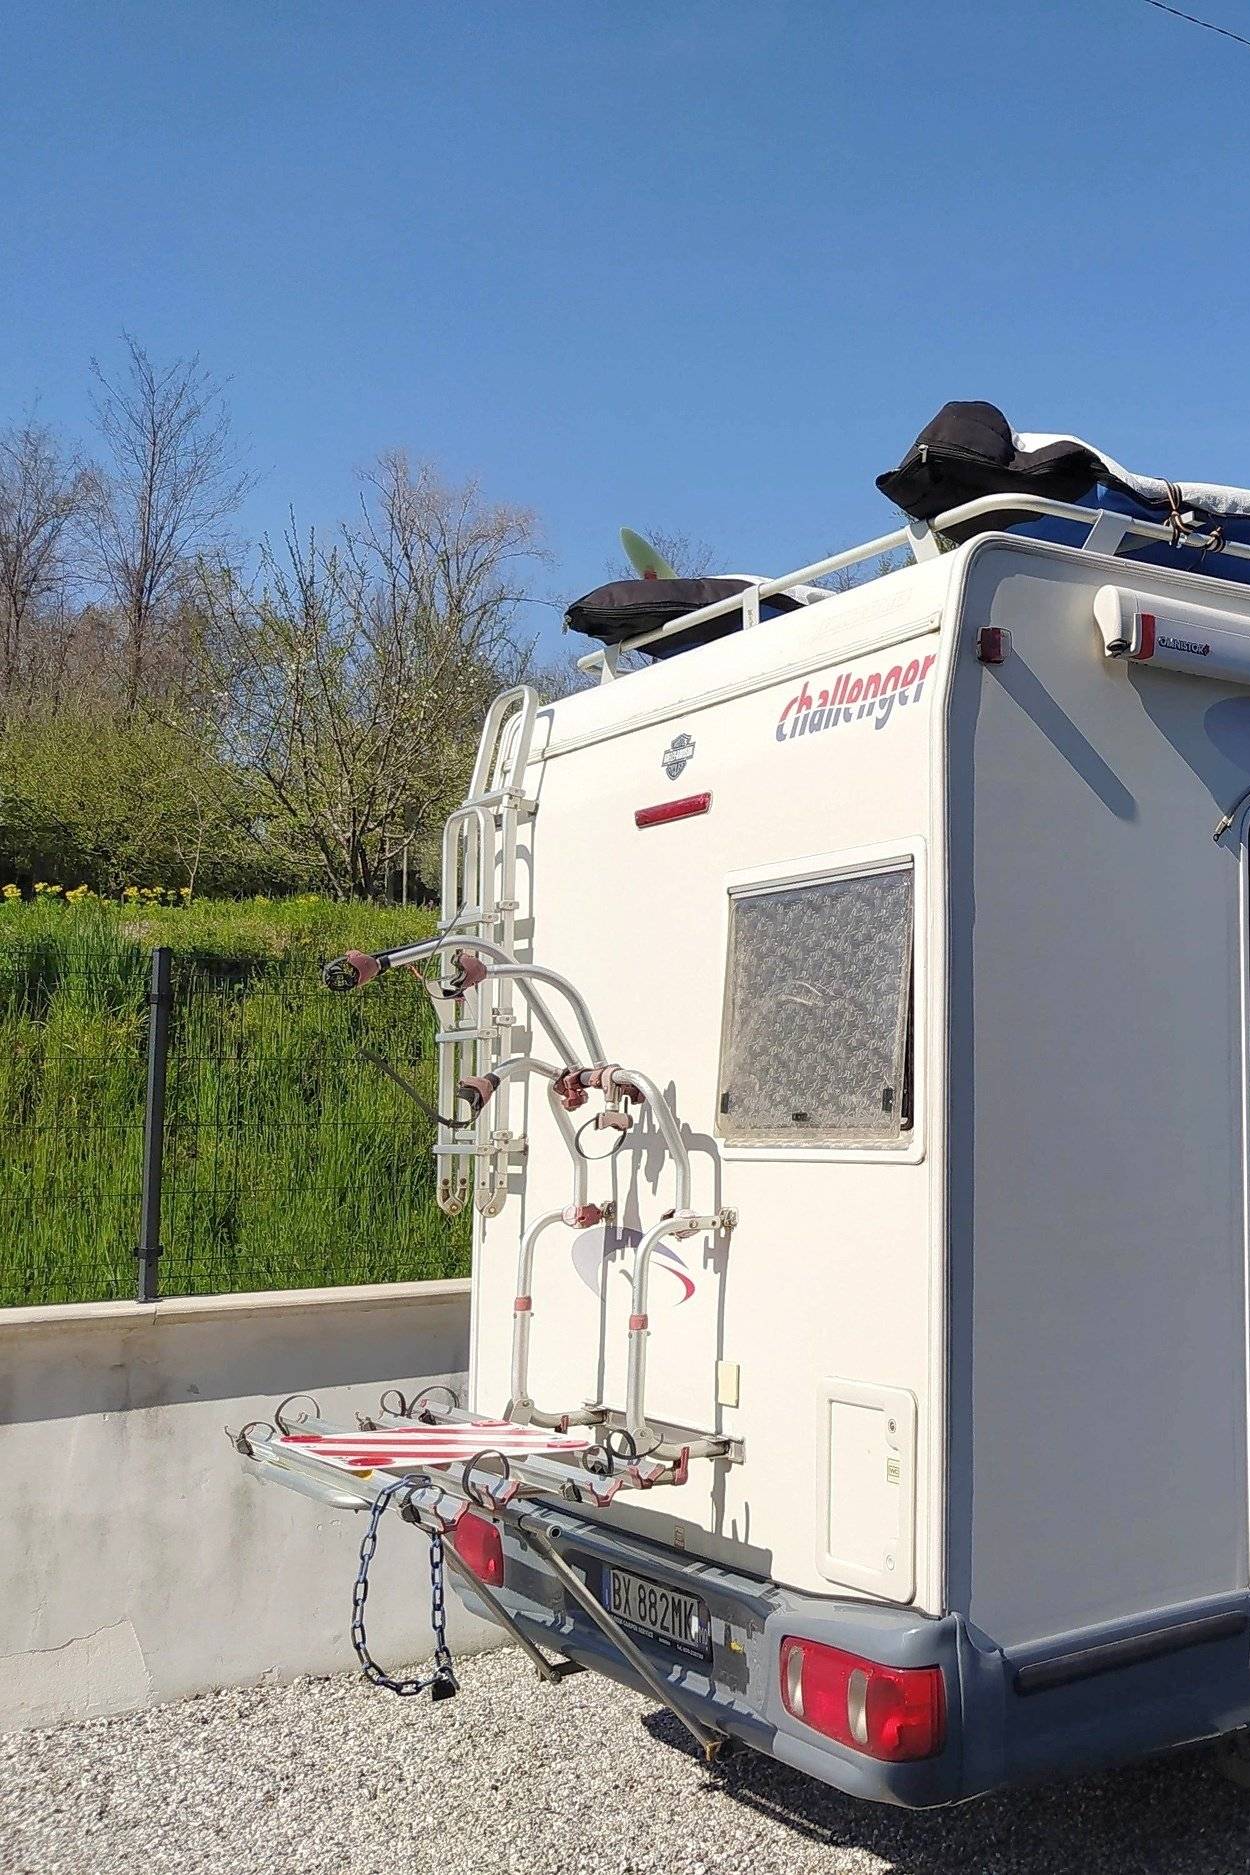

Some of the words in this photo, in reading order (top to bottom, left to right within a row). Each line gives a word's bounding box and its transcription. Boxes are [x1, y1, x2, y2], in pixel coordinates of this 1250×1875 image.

[775, 653, 937, 742] challenger
[612, 1571, 631, 1617] BX
[638, 1584, 695, 1642] 882MK
